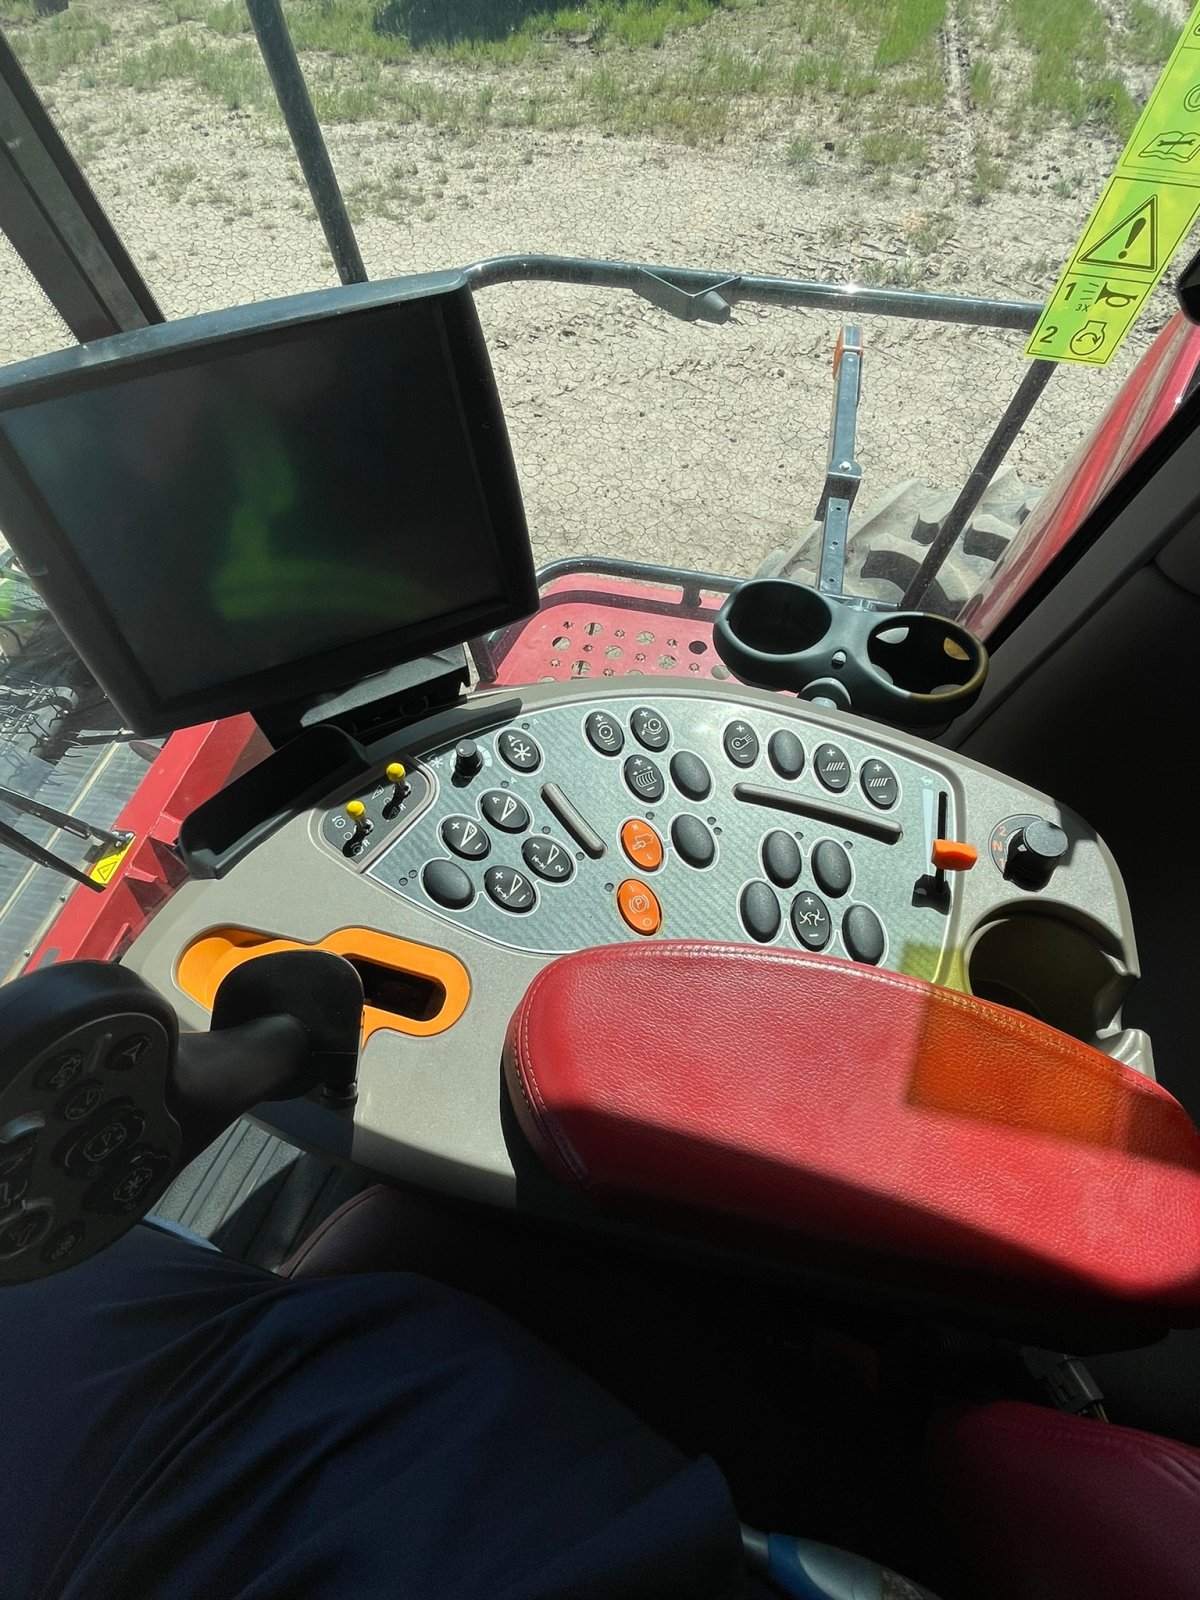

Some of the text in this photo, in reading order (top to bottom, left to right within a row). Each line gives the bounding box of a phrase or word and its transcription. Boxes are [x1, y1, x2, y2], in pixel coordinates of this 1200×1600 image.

[1064, 282, 1077, 301] 1
[1040, 326, 1058, 343] 2
[507, 734, 517, 742] A
[492, 796, 501, 804] A
[999, 825, 1007, 836] 2
[992, 840, 1003, 852] N
[554, 864, 564, 873] 2
